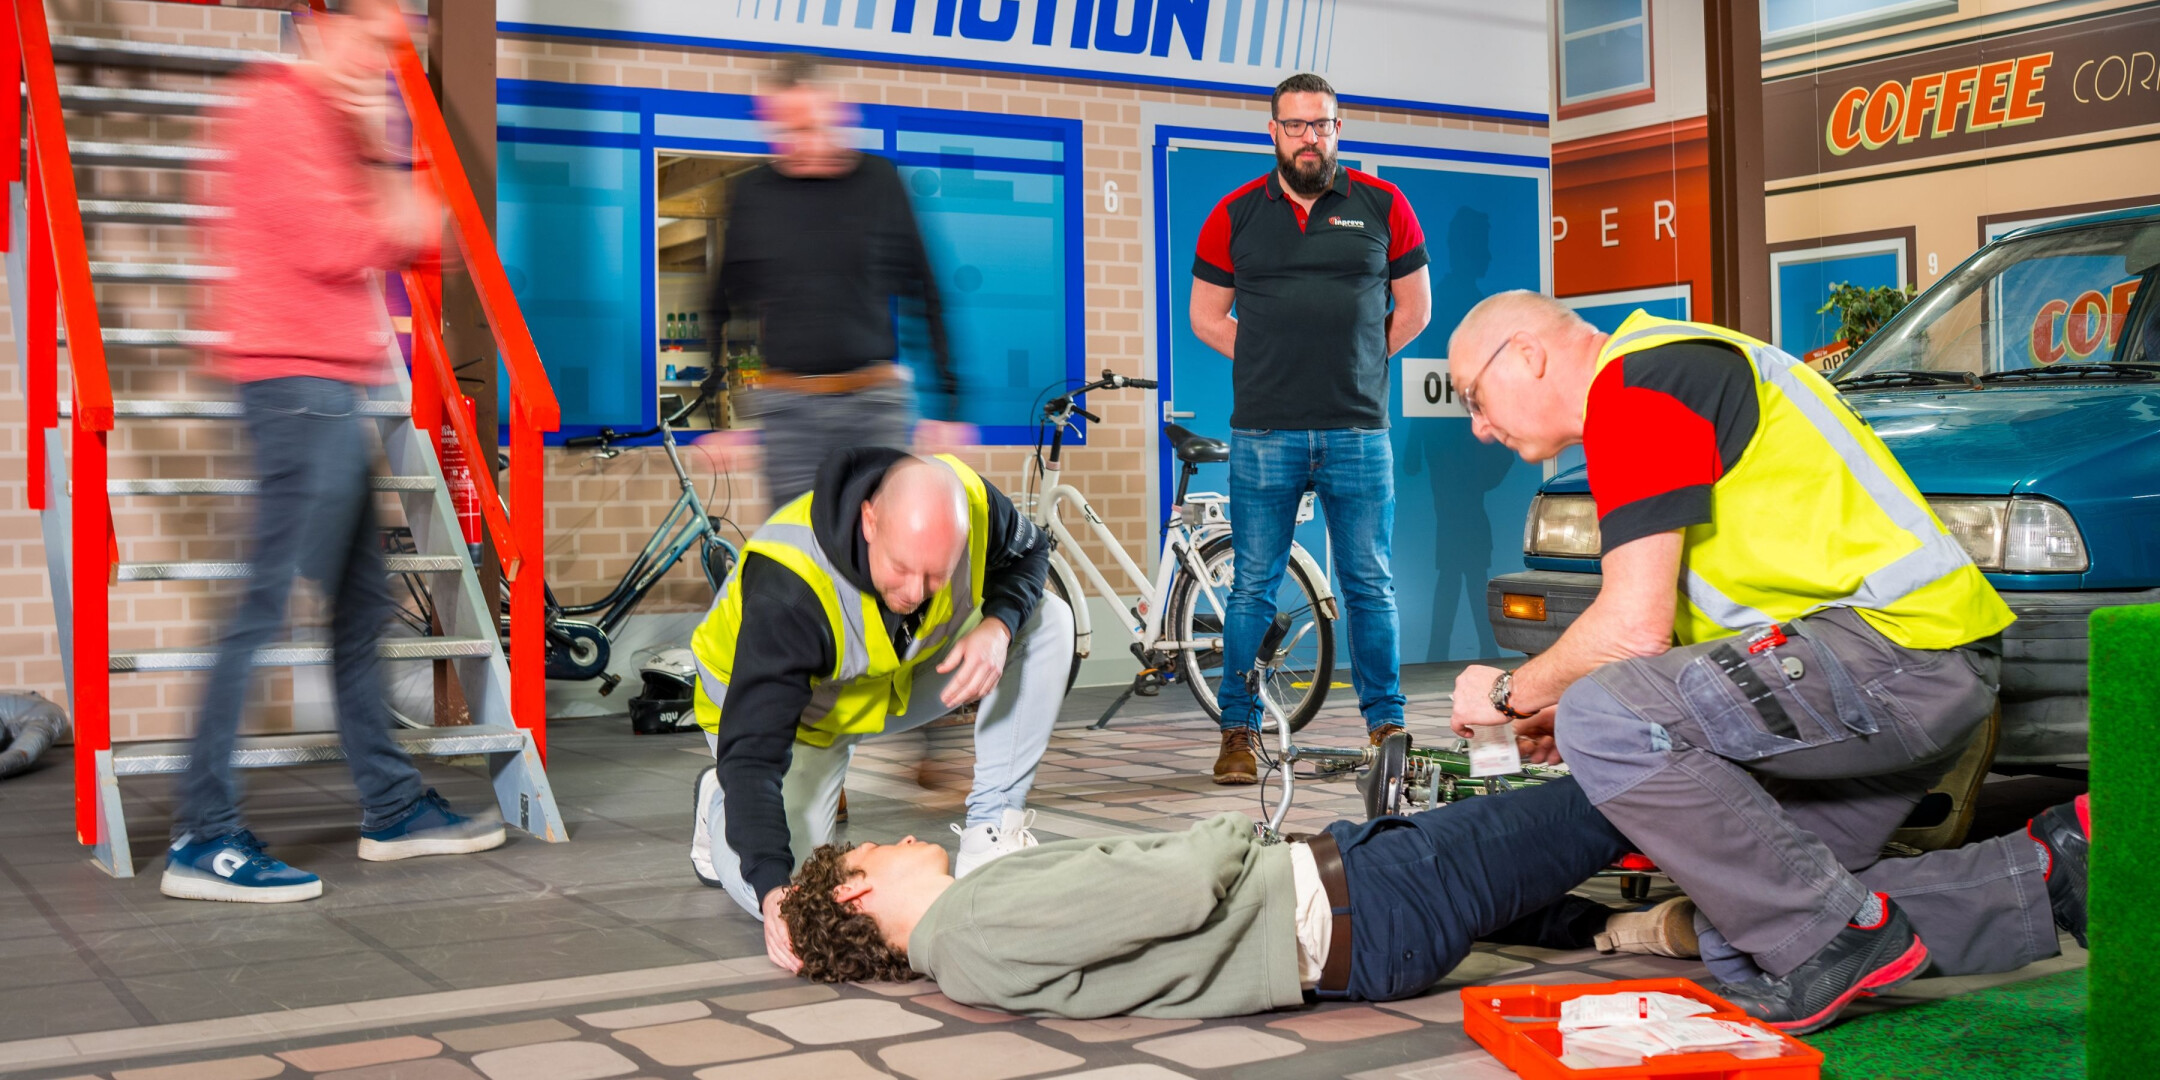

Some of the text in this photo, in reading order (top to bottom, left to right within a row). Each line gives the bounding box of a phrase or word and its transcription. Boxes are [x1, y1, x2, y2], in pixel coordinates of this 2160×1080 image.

[1826, 51, 2160, 156] COFFEE COR
[1104, 180, 1118, 213] 6
[1928, 252, 1938, 275] 9
